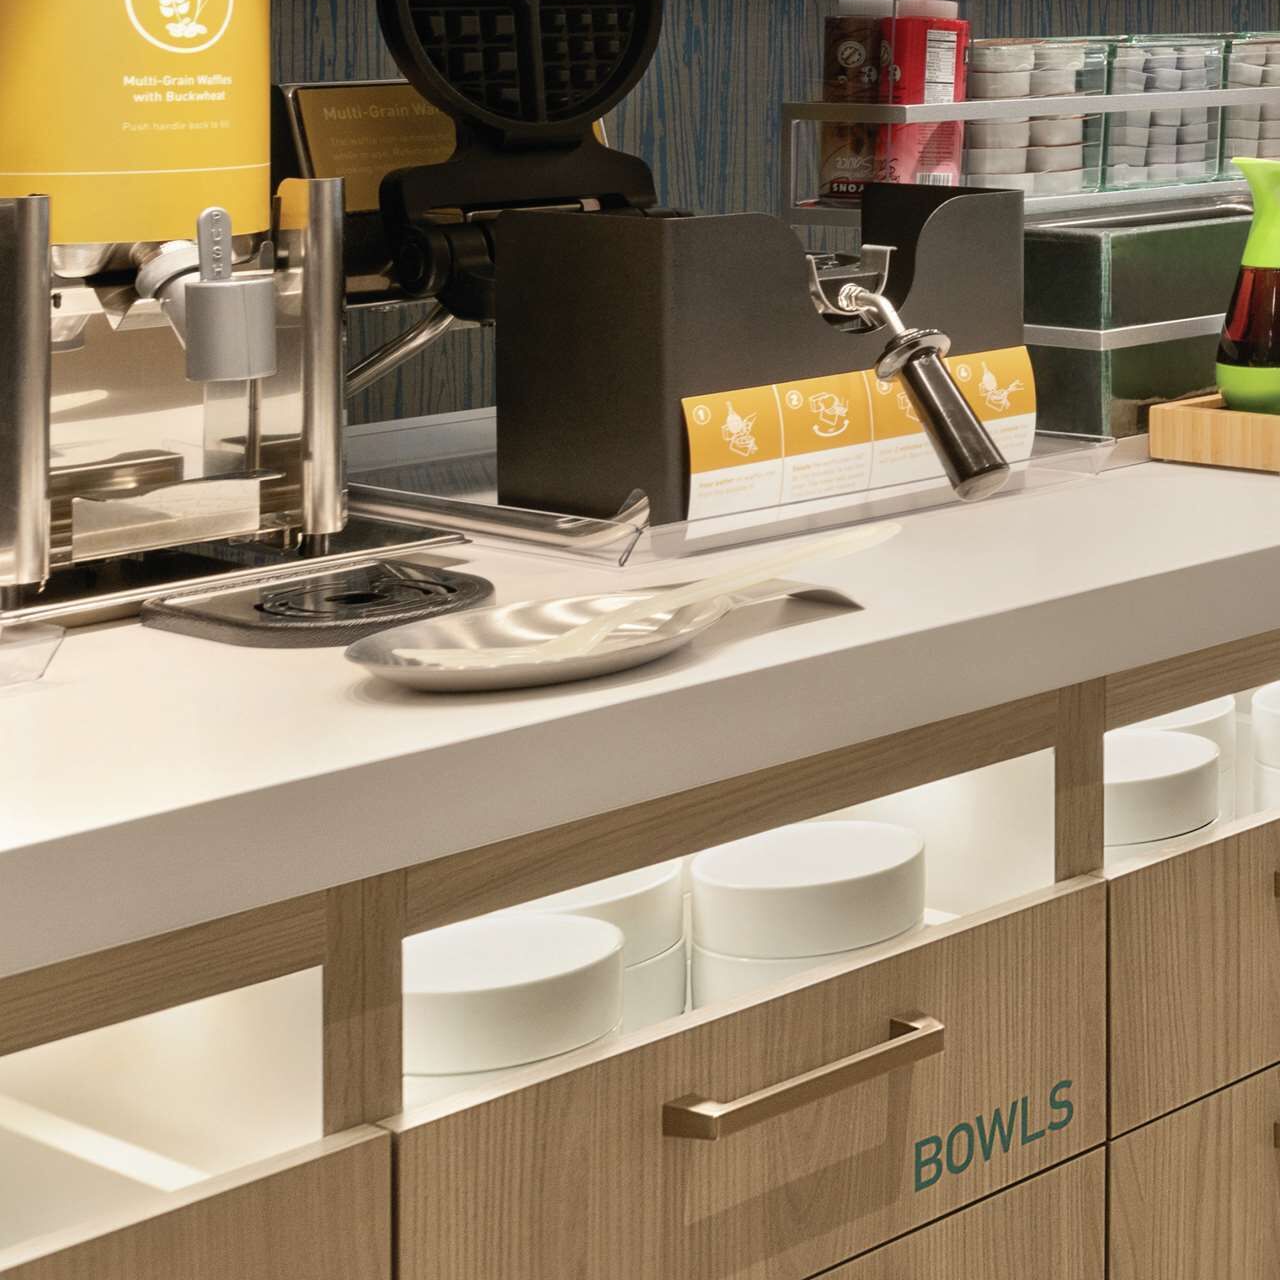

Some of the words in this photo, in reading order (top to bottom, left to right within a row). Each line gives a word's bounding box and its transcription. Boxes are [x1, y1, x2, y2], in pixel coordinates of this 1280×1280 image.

[122, 74, 195, 87] Multi-Grain
[197, 74, 232, 85] Waffles
[132, 91, 162, 102] with
[166, 91, 225, 102] Buckwheat
[322, 104, 409, 121] Multi-Grain
[210, 210, 224, 276] PUSH
[912, 1078, 1075, 1192] BOWLS
